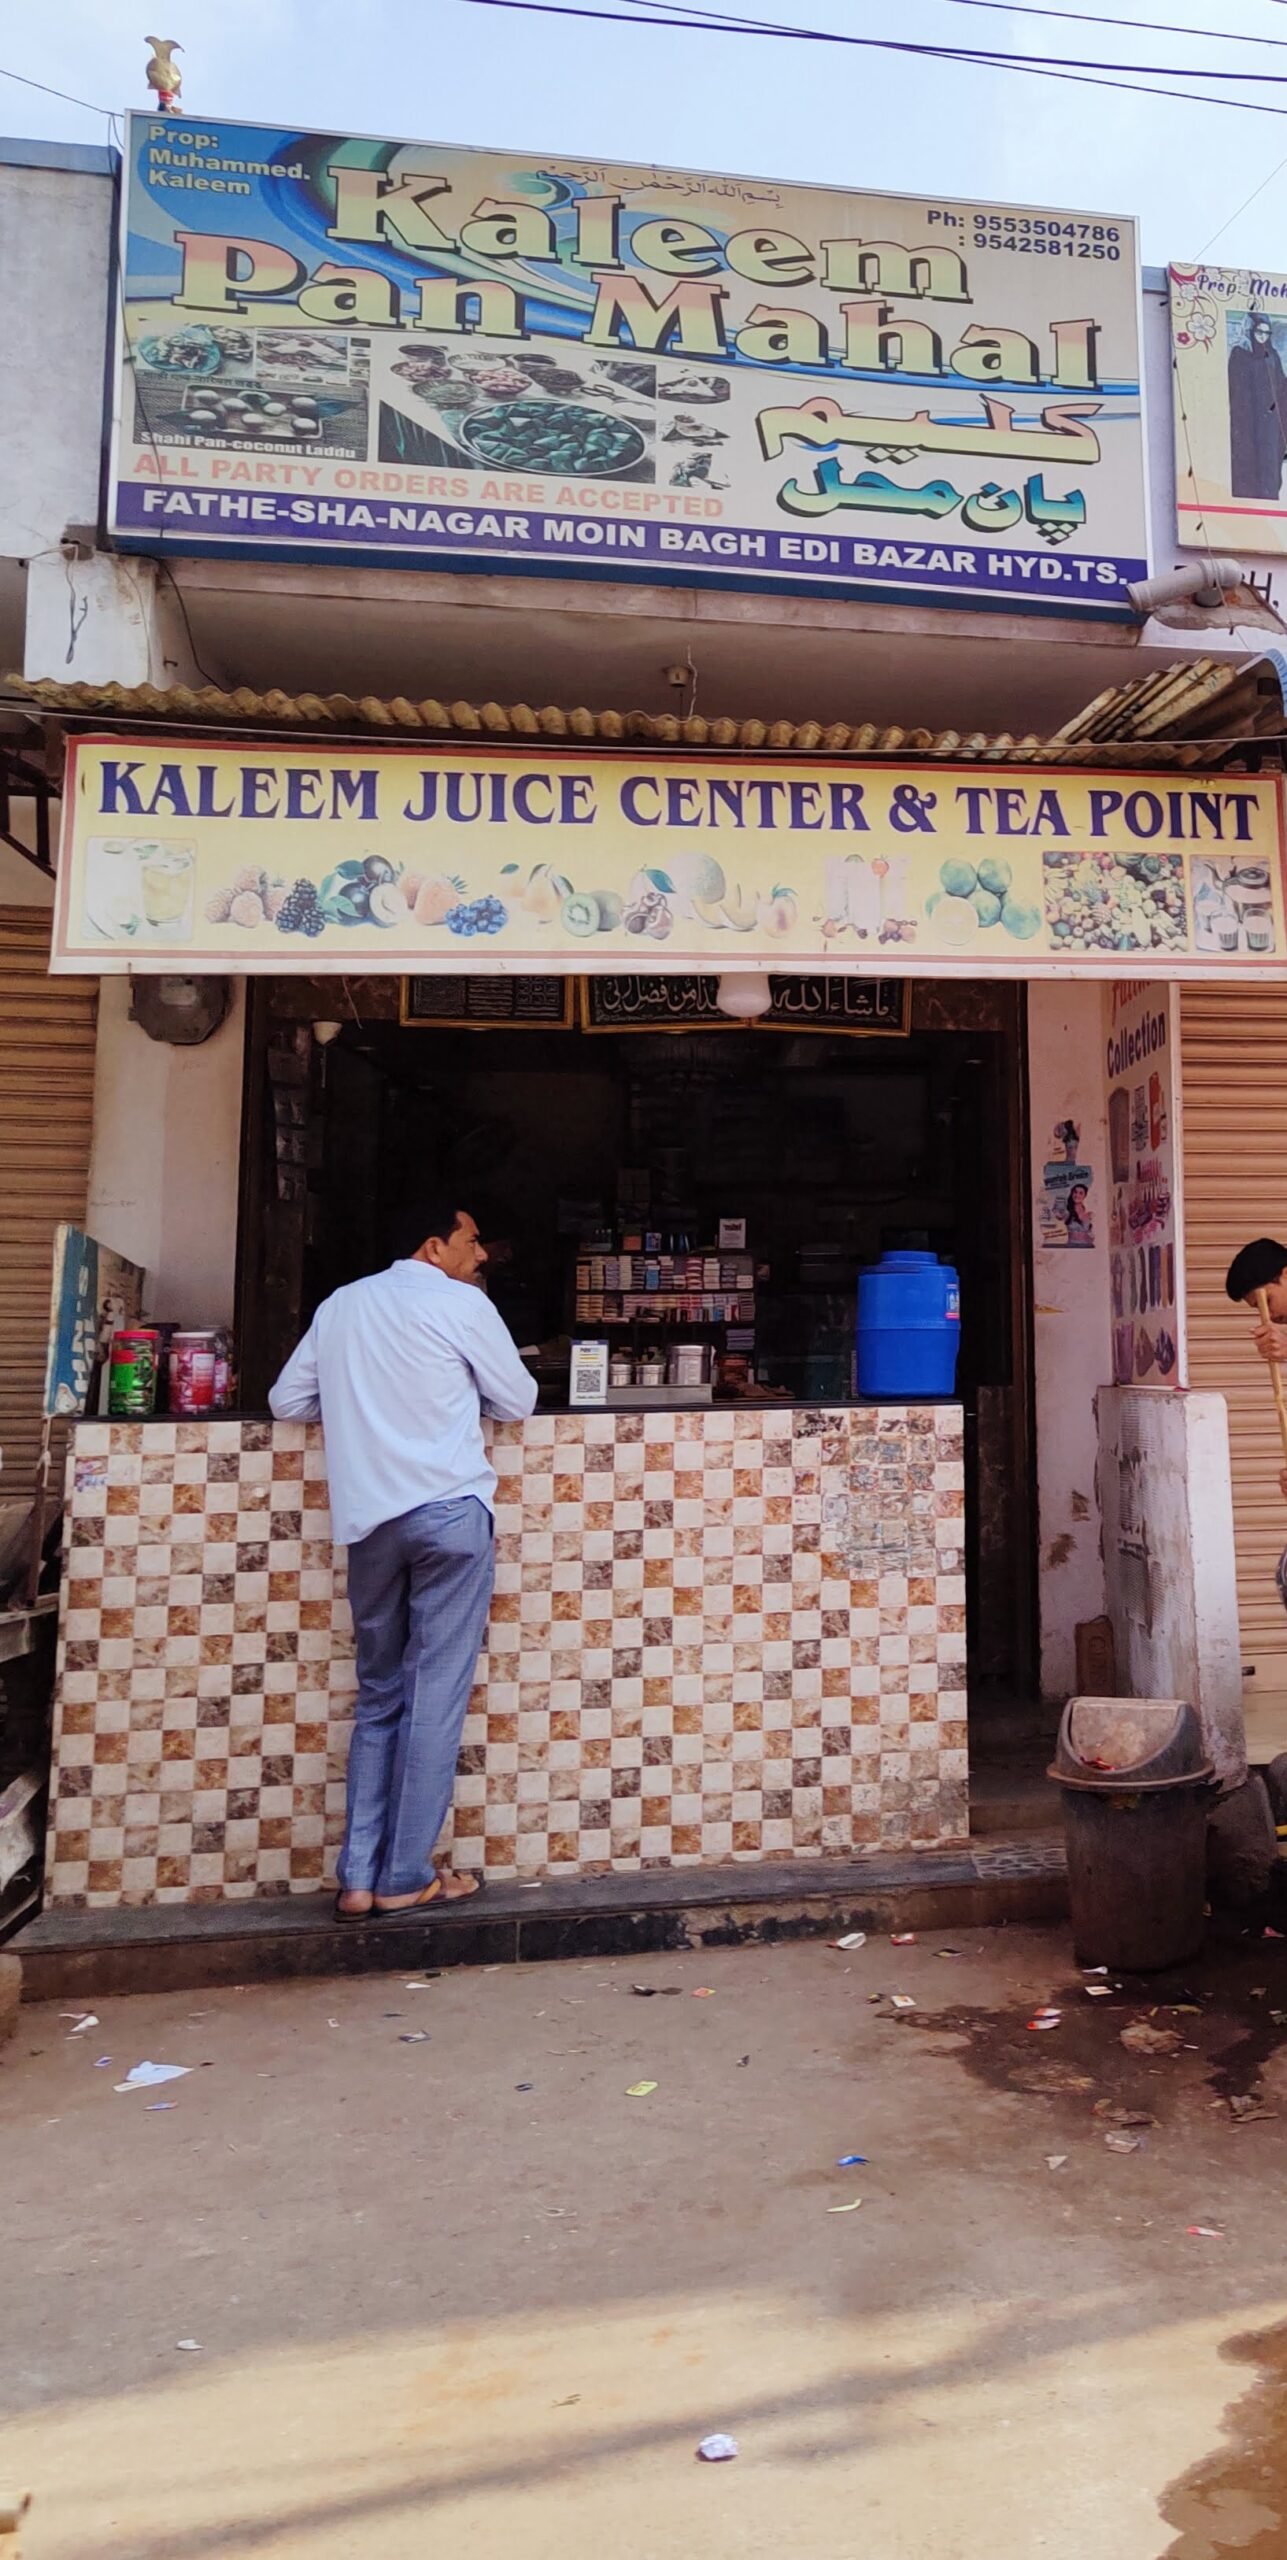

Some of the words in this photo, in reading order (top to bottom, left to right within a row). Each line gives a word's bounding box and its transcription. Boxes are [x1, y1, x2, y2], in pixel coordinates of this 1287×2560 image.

[149, 126, 219, 149] Prop:
[149, 148, 311, 180] Muhammed.
[149, 170, 251, 195] Kaleem
[326, 166, 973, 303] Kaleem
[927, 210, 965, 227] Ph:
[973, 214, 1120, 243] 9553504786
[973, 233, 1121, 261] 9542581250
[172, 231, 530, 340] Pan
[583, 272, 1104, 389] Mahal
[140, 431, 191, 446] Shahi
[194, 435, 302, 454] Pan-coconut
[306, 444, 356, 459] Laddu
[133, 453, 199, 477] ALL
[211, 459, 323, 486] PARTY
[334, 468, 469, 498] ORDERS
[480, 480, 545, 503] ARE
[556, 485, 723, 517] ACCEPTED
[143, 489, 532, 540] FATHE-SHA-NAGAR
[544, 519, 646, 548] MOIN
[659, 528, 766, 558] BAGH
[779, 538, 839, 563] EDI
[853, 543, 977, 574] BAZAR
[988, 554, 1129, 585] HYD.TS.
[98, 761, 380, 820] KALEEM
[402, 771, 598, 825] JUICE
[620, 776, 871, 832] CENTER
[888, 784, 938, 833] &
[954, 787, 1072, 836] TEA
[1089, 790, 1260, 841] POINT
[1106, 1011, 1166, 1079] Collection
